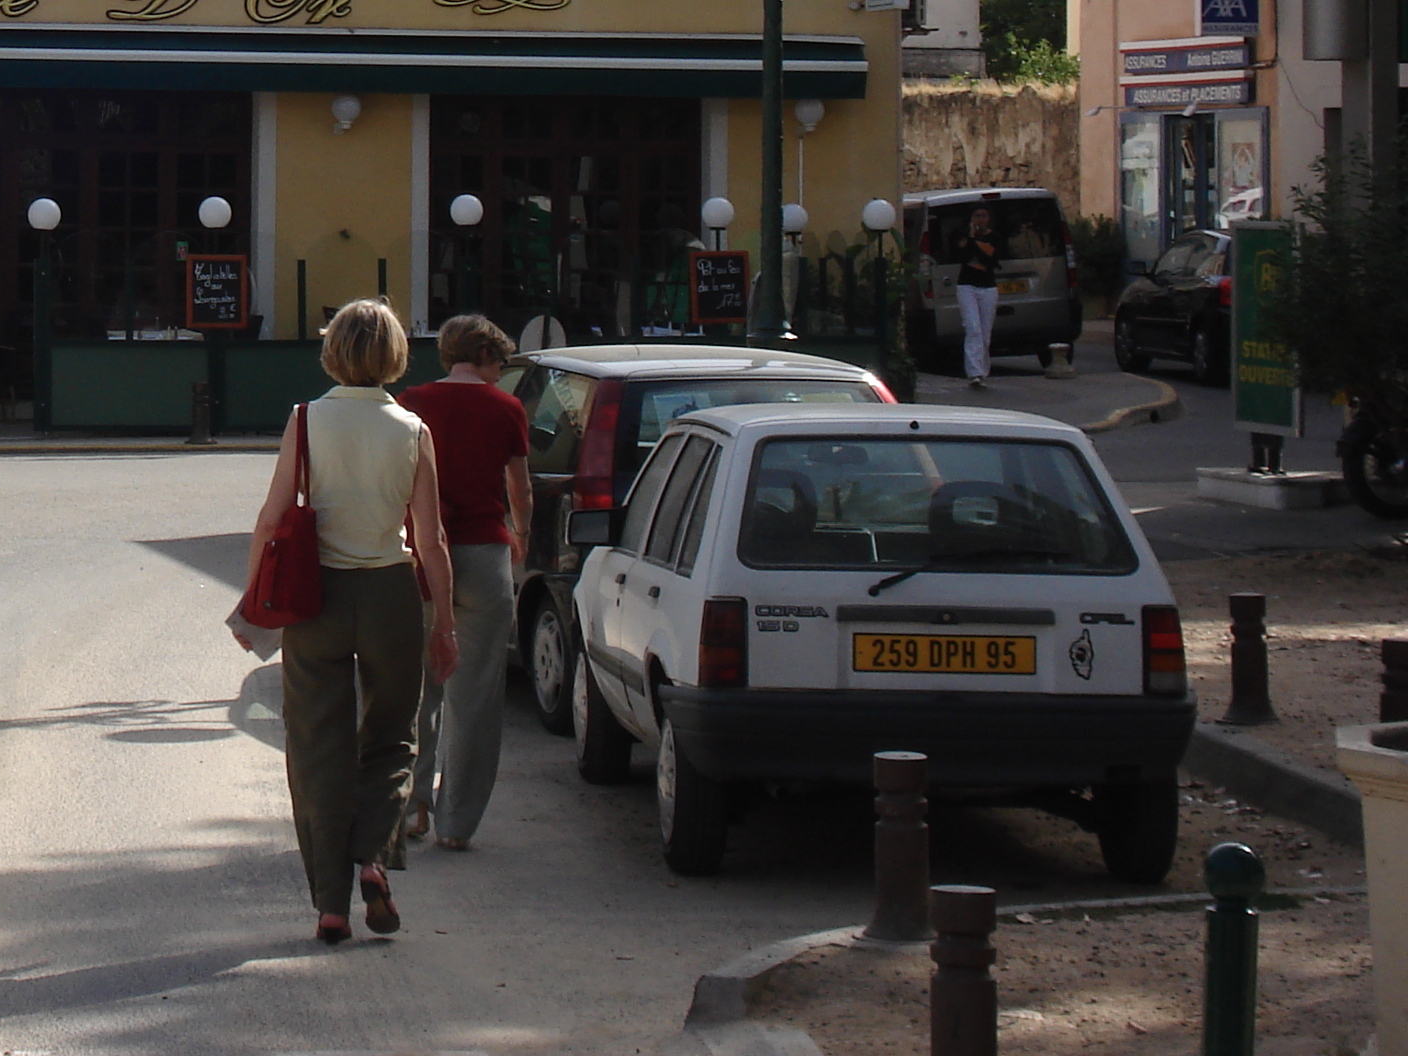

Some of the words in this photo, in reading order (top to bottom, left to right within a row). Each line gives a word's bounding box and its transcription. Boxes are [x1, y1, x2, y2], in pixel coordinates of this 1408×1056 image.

[1125, 54, 1167, 70] ASSURANCES
[1134, 88, 1180, 104] ASSURANCES
[1191, 85, 1242, 102] PLACEMENTS
[755, 605, 829, 618] CORSA
[872, 638, 919, 668] 259
[929, 640, 976, 669] DPH
[986, 641, 1017, 669] 95
